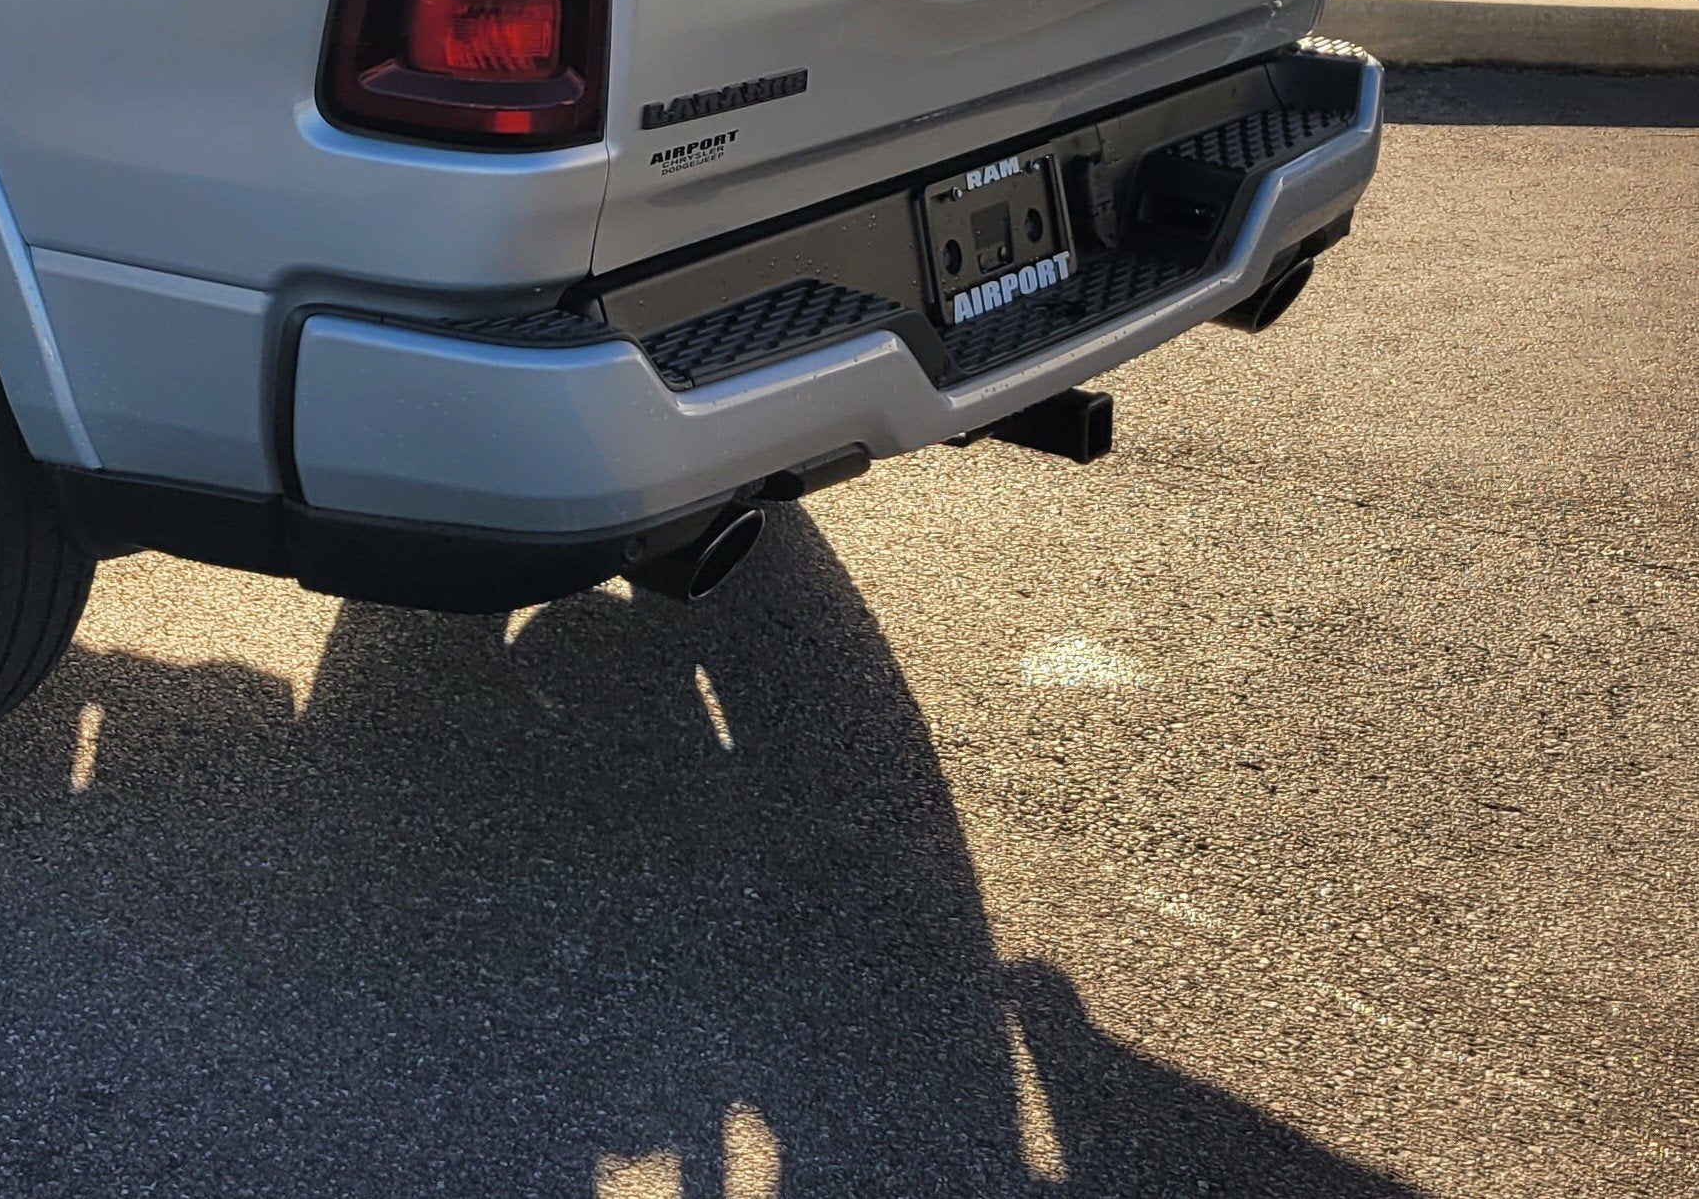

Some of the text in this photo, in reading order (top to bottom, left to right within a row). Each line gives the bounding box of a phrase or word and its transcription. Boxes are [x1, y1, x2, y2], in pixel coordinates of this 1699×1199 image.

[650, 130, 739, 165] AIRPORT
[662, 145, 725, 168] CHRYSLER
[966, 157, 1020, 190] RAM
[954, 251, 1070, 324] AIRPORT
